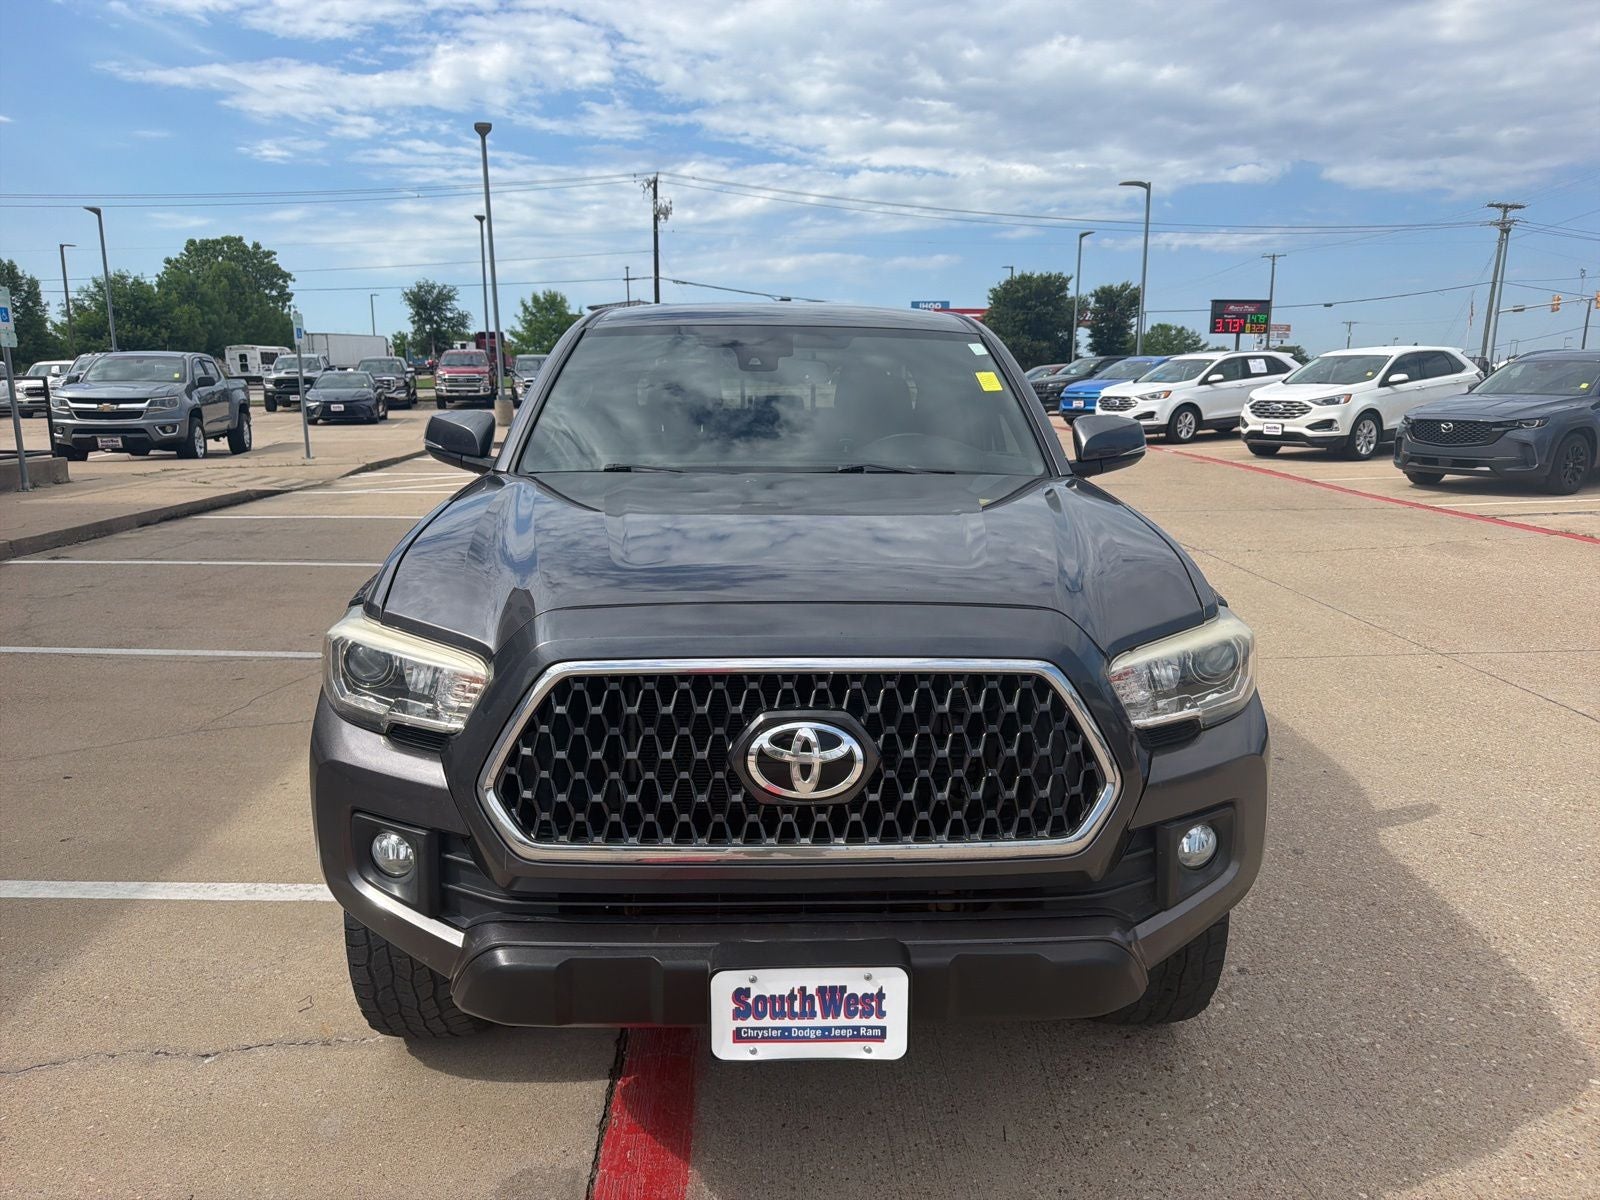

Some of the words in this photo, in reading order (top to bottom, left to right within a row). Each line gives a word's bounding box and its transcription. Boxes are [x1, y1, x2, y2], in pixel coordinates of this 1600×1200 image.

[732, 985, 887, 1021] SouthWest
[741, 1028, 782, 1039] Chrysler
[791, 1028, 822, 1038] Dodge
[830, 1027, 853, 1037] Jeep
[860, 1027, 881, 1036] Ram
